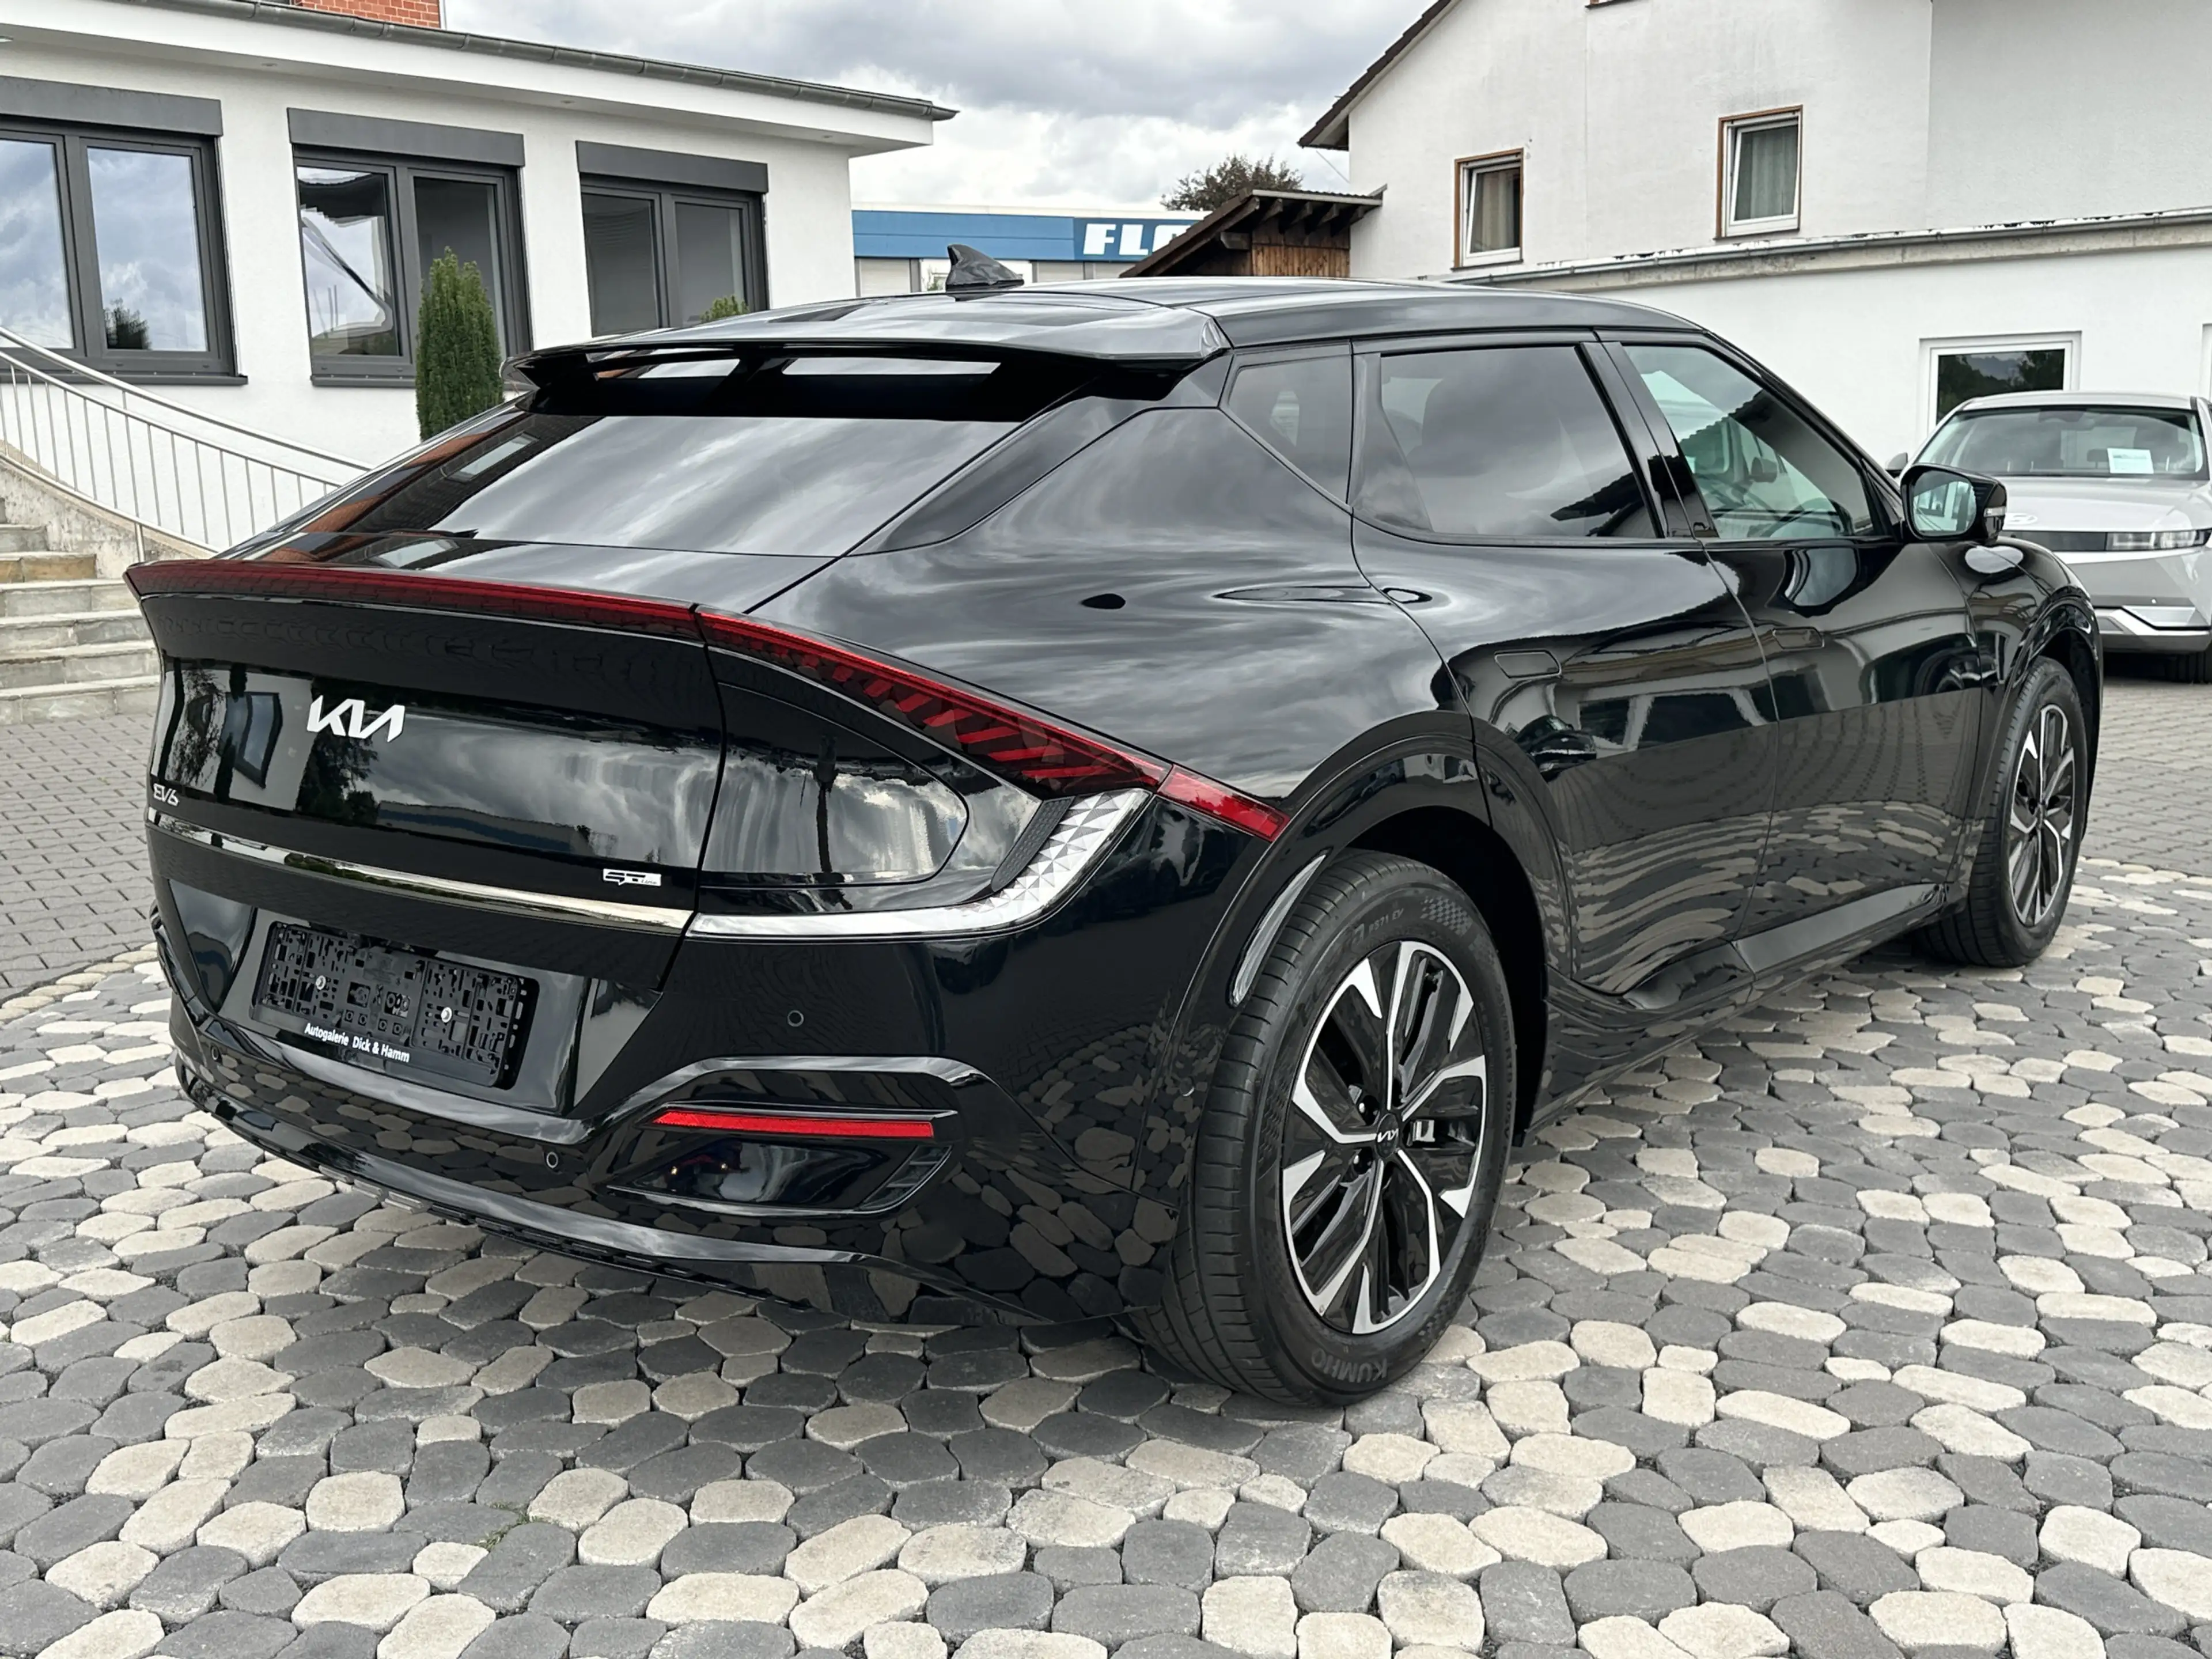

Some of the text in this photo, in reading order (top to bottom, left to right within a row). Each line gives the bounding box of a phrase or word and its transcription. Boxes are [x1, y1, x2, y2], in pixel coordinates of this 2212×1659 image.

[306, 695, 406, 743] KIA
[153, 783, 179, 806] EV6
[304, 1022, 410, 1063] Autogalerie Dick & Hamm
[1311, 1348, 1388, 1383] KUMHO
